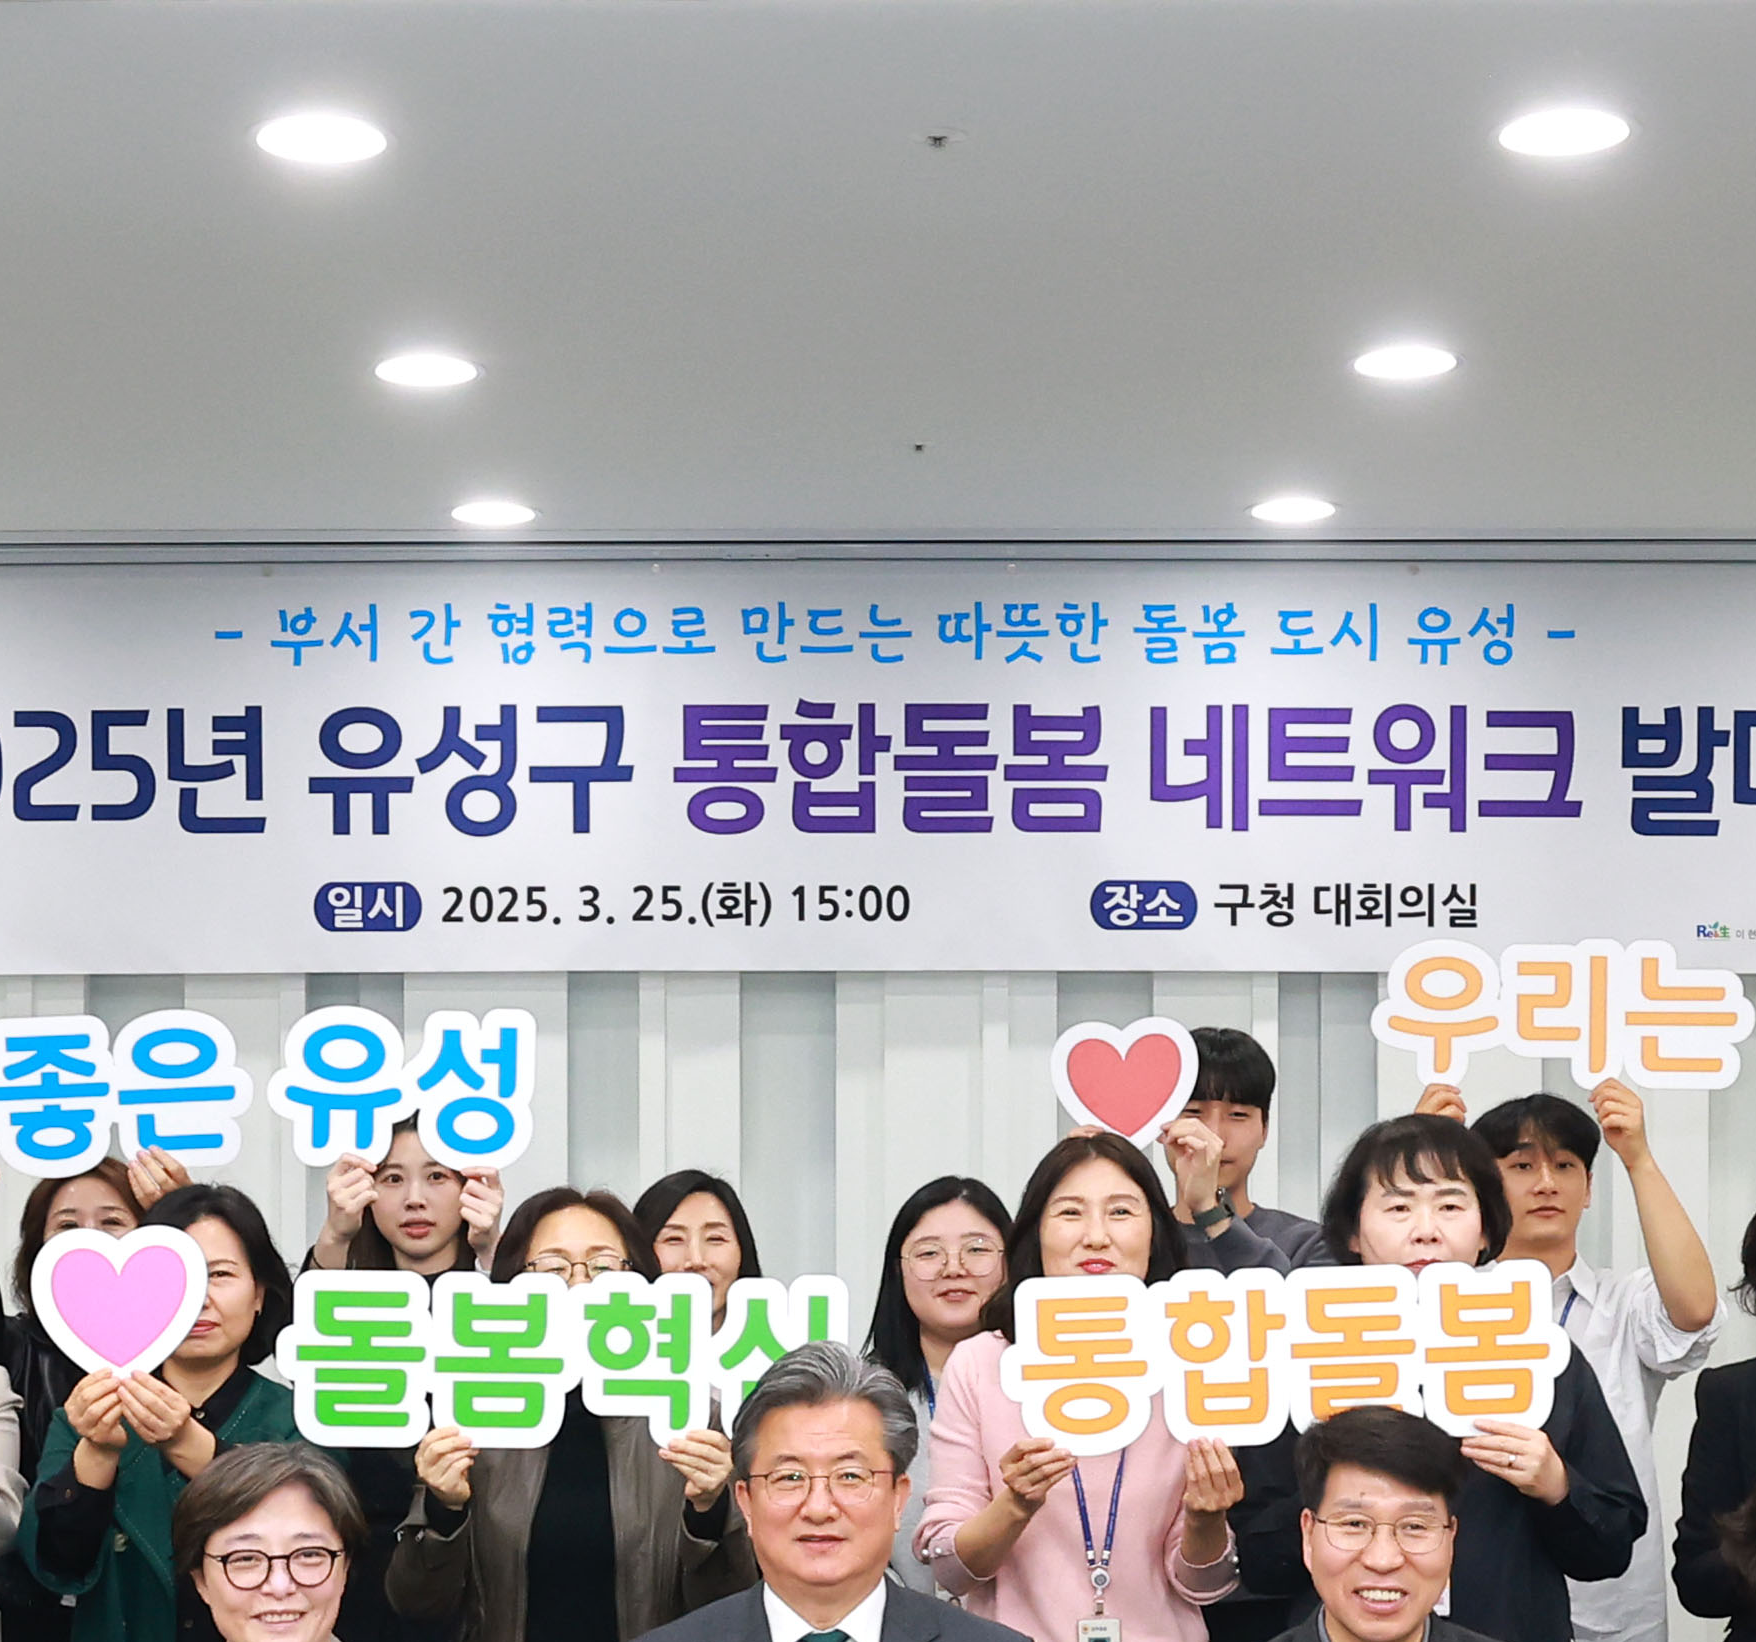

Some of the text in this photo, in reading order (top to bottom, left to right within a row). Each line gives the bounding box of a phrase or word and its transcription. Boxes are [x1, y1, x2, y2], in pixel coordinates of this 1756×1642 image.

[270, 603, 378, 667] 부서
[409, 602, 462, 665] 간
[487, 601, 716, 665] 협력으로
[741, 601, 913, 664] 만드는
[938, 601, 1109, 664] 따뜻한
[1133, 602, 1246, 665] 돌봄
[1271, 602, 1378, 662] 도시
[1407, 603, 1515, 666] 유성
[309, 704, 634, 837] 유성구
[674, 699, 1109, 835] 통합돌봄
[1150, 704, 1583, 833] 네트워크
[327, 881, 911, 928] 일시 2025. 3. 25.(화) 15:00
[1103, 882, 1479, 929] 장소 구청 대회의실
[1388, 955, 1739, 1074] 우리는
[284, 1023, 519, 1156] 유성
[1021, 1280, 1551, 1436] 통합돌봄
